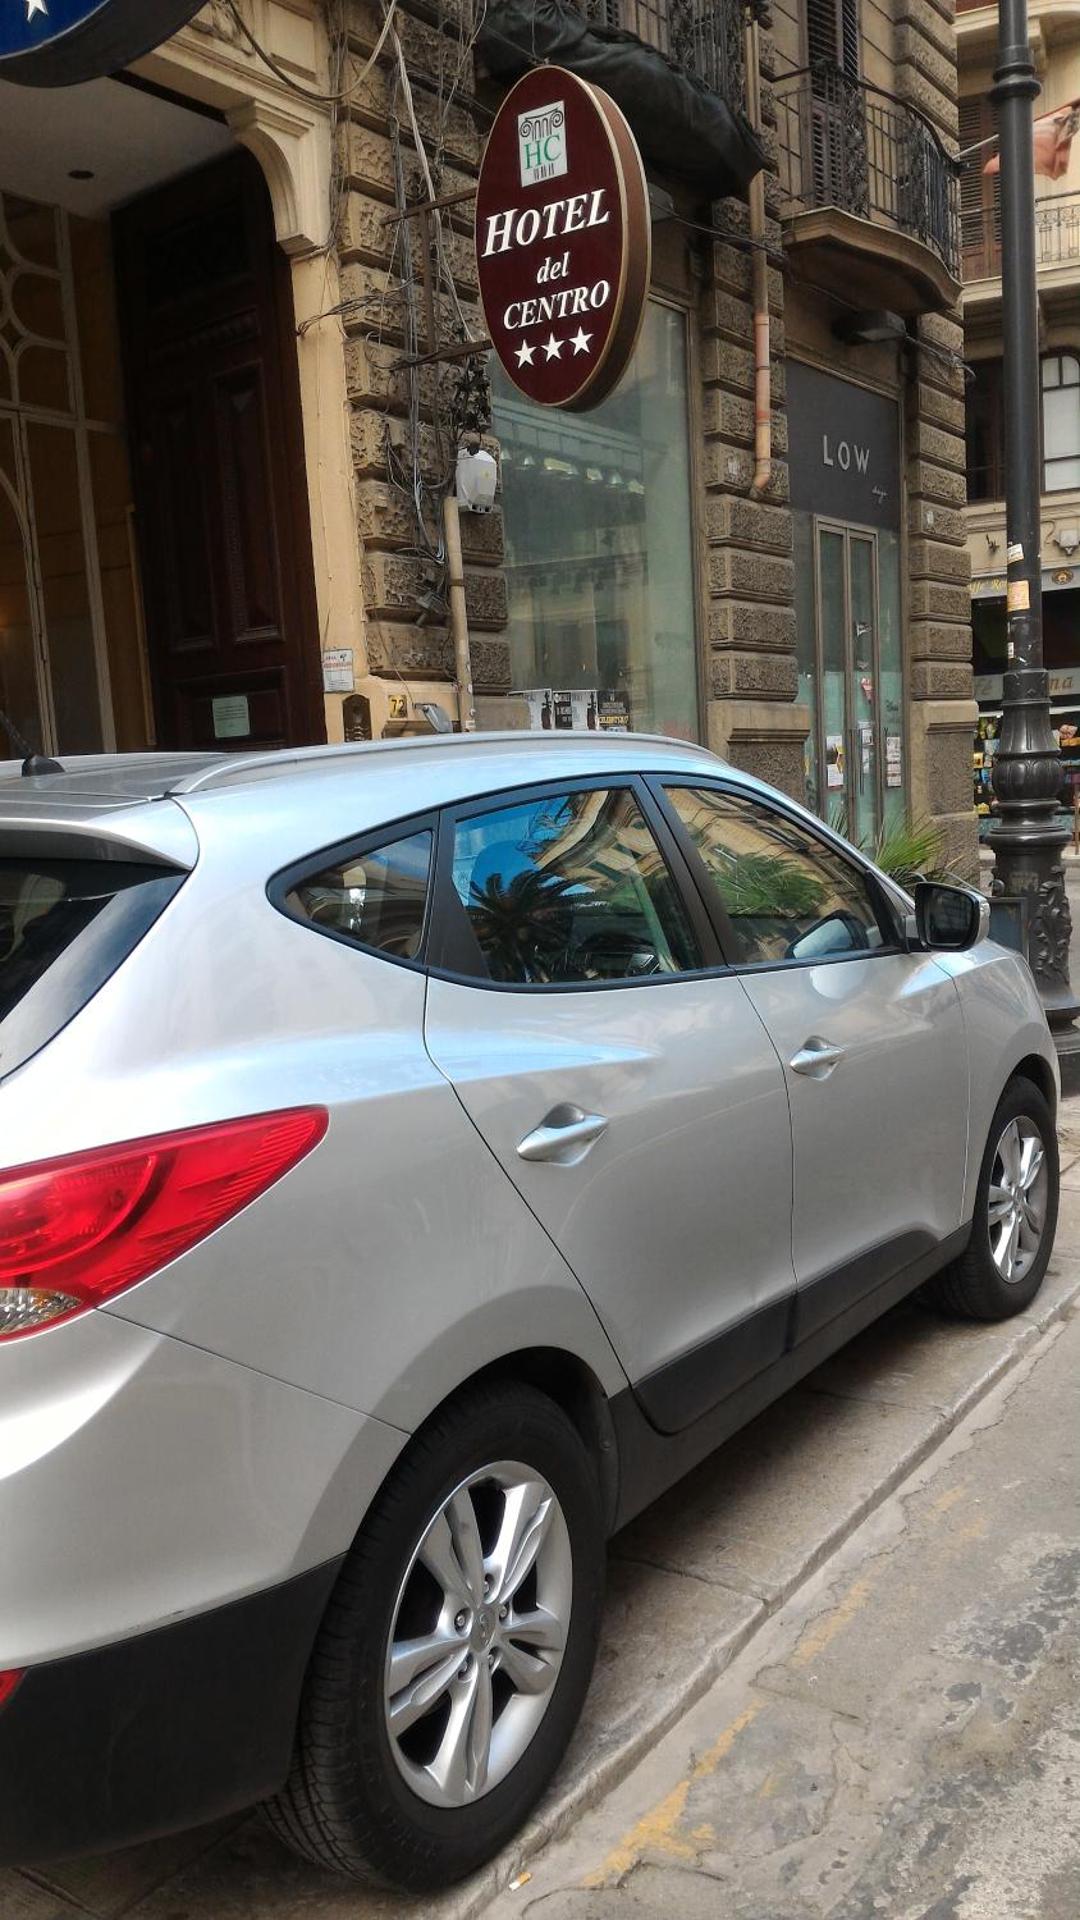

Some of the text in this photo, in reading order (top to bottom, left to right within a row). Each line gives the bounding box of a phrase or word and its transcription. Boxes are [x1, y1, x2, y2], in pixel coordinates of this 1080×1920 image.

[524, 134, 561, 170] HC
[482, 189, 610, 257] HOTEL
[537, 251, 570, 284] del
[503, 280, 610, 330] CENTRO
[823, 434, 870, 475] LOW
